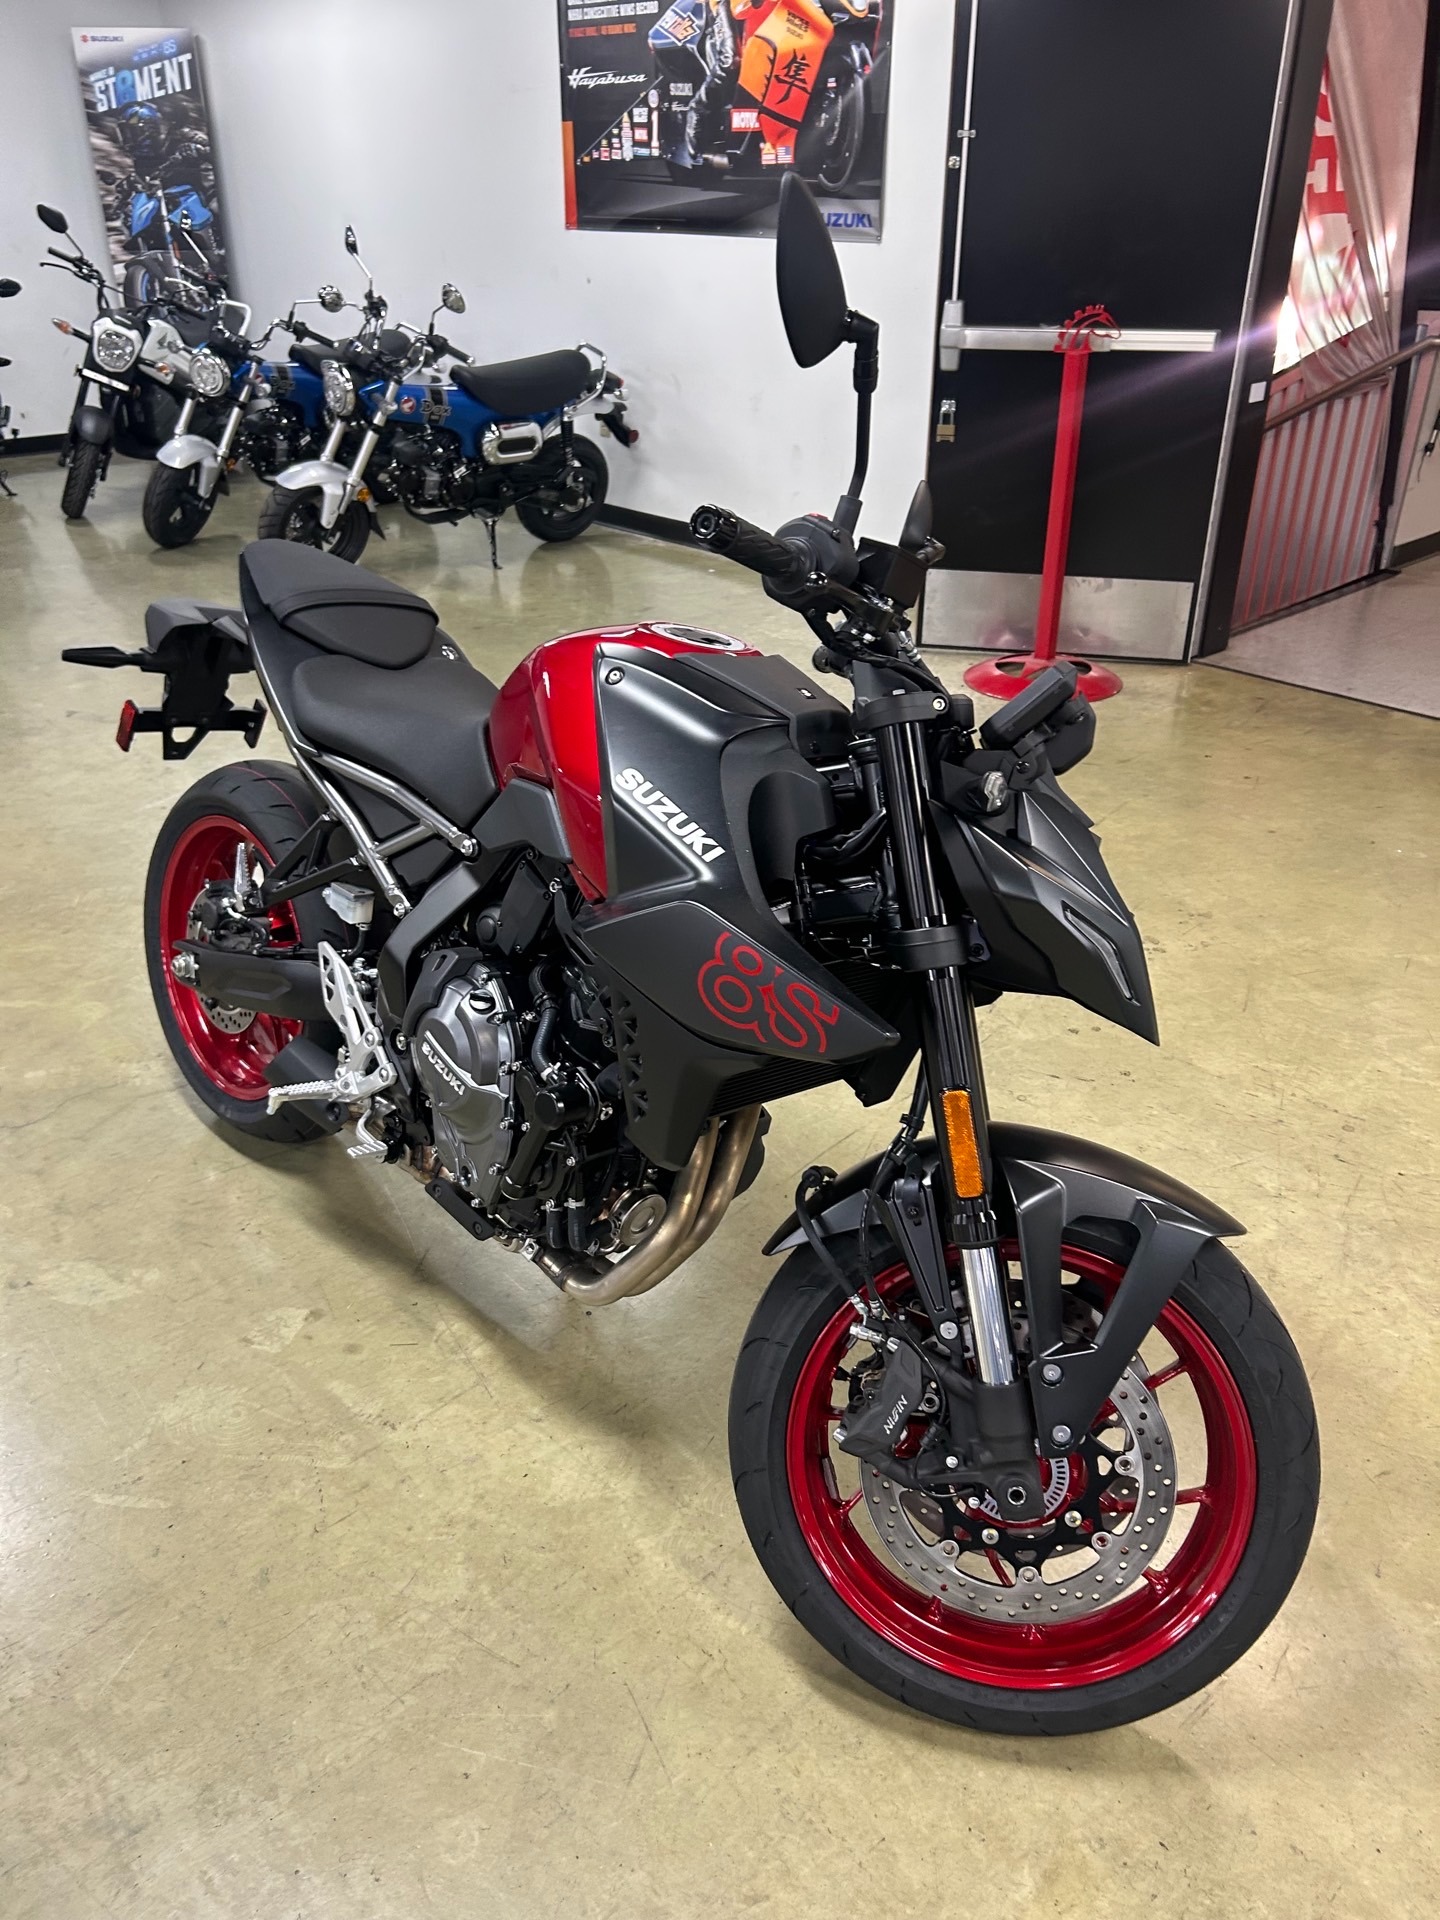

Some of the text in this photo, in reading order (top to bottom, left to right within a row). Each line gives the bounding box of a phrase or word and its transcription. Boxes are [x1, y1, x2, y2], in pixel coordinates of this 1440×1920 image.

[567, 66, 648, 89] Hayabusa
[774, 49, 812, 105] 隼
[824, 212, 873, 228] UZUKI
[420, 398, 453, 416] Dax
[615, 767, 726, 863] SUZUKI
[421, 1041, 466, 1096] SUZUKI
